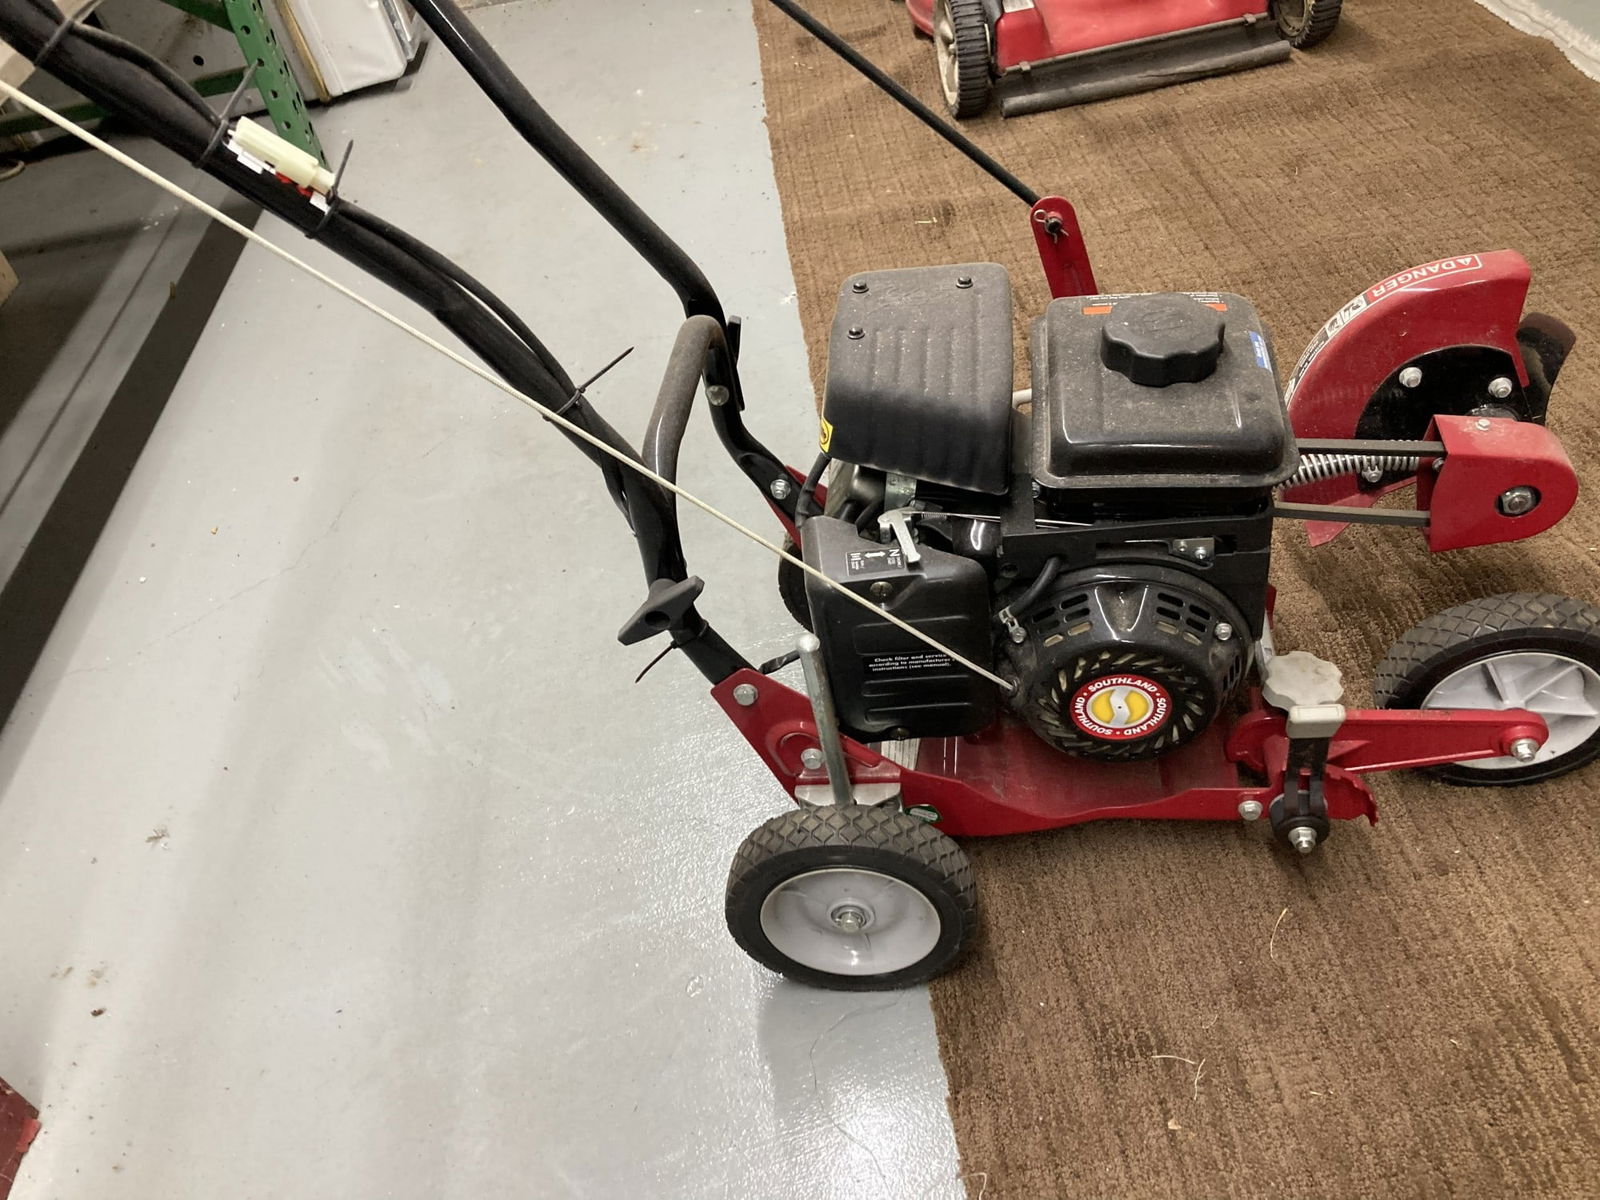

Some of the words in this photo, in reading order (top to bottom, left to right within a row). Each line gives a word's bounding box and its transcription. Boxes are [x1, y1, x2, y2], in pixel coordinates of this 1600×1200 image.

[1372, 260, 1457, 298] DANGER
[1088, 677, 1158, 693] SOUTHLAND
[1074, 696, 1113, 736] SOUTHLAND
[1123, 697, 1167, 736] SOUTHLAND
